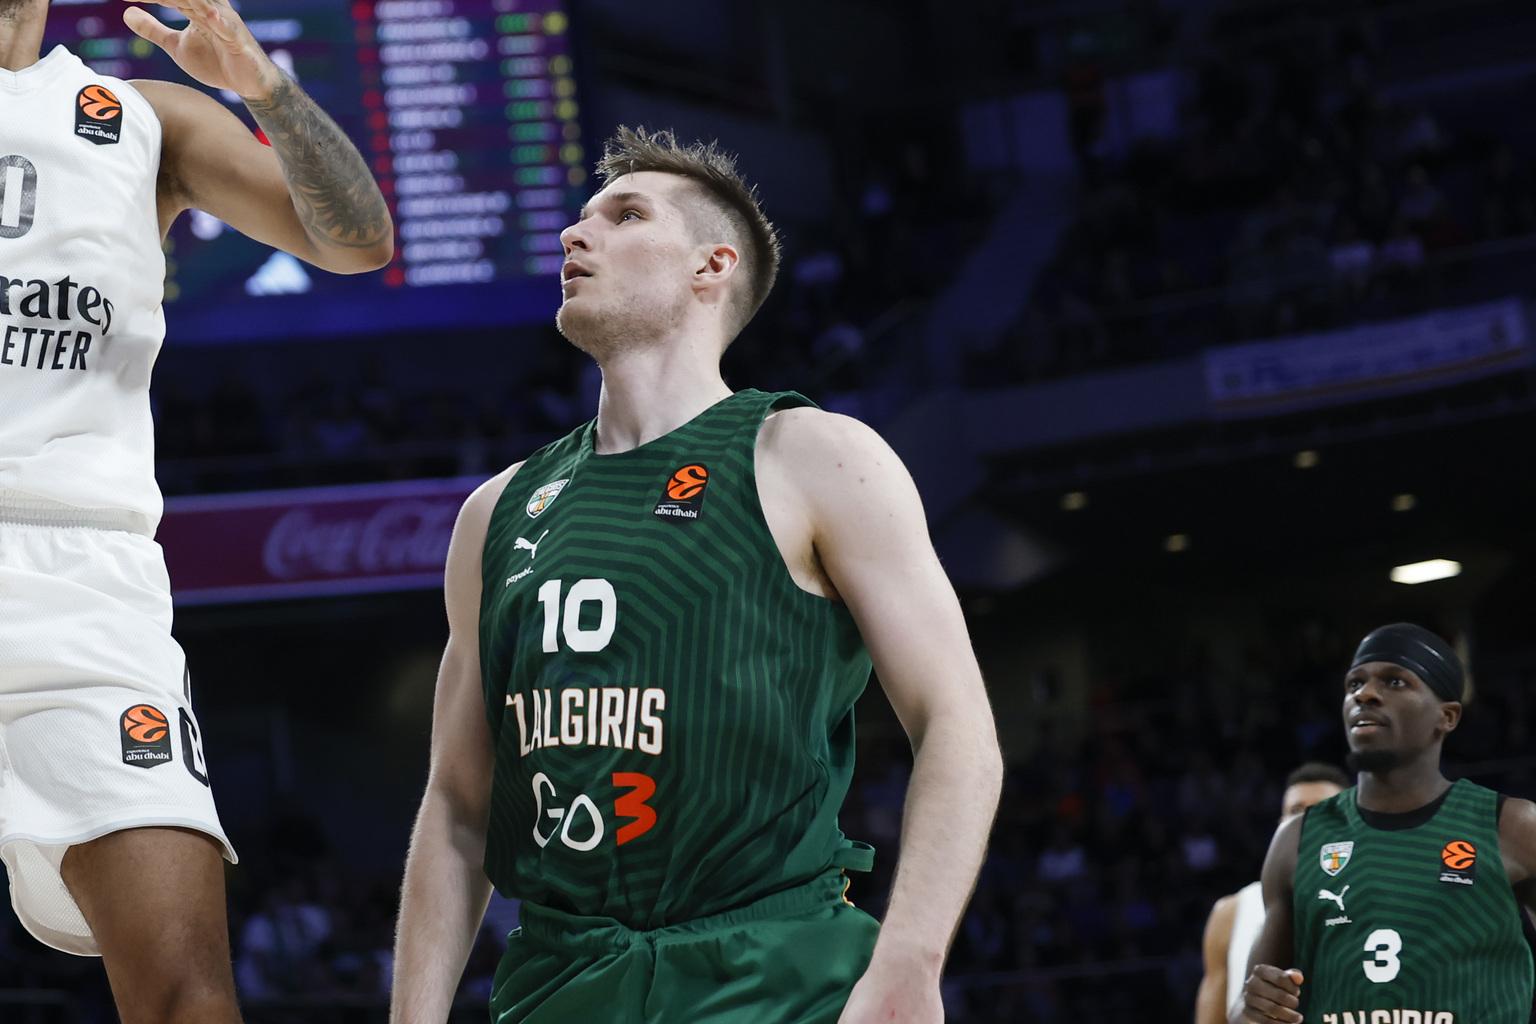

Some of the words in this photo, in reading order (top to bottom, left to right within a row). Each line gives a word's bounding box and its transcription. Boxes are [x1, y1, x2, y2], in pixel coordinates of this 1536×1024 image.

[654, 507, 672, 516] abu
[671, 508, 699, 519] dhabi
[537, 578, 617, 653] 10
[125, 752, 144, 761] abu
[144, 751, 170, 760] dhabi
[1363, 928, 1403, 984] 3
